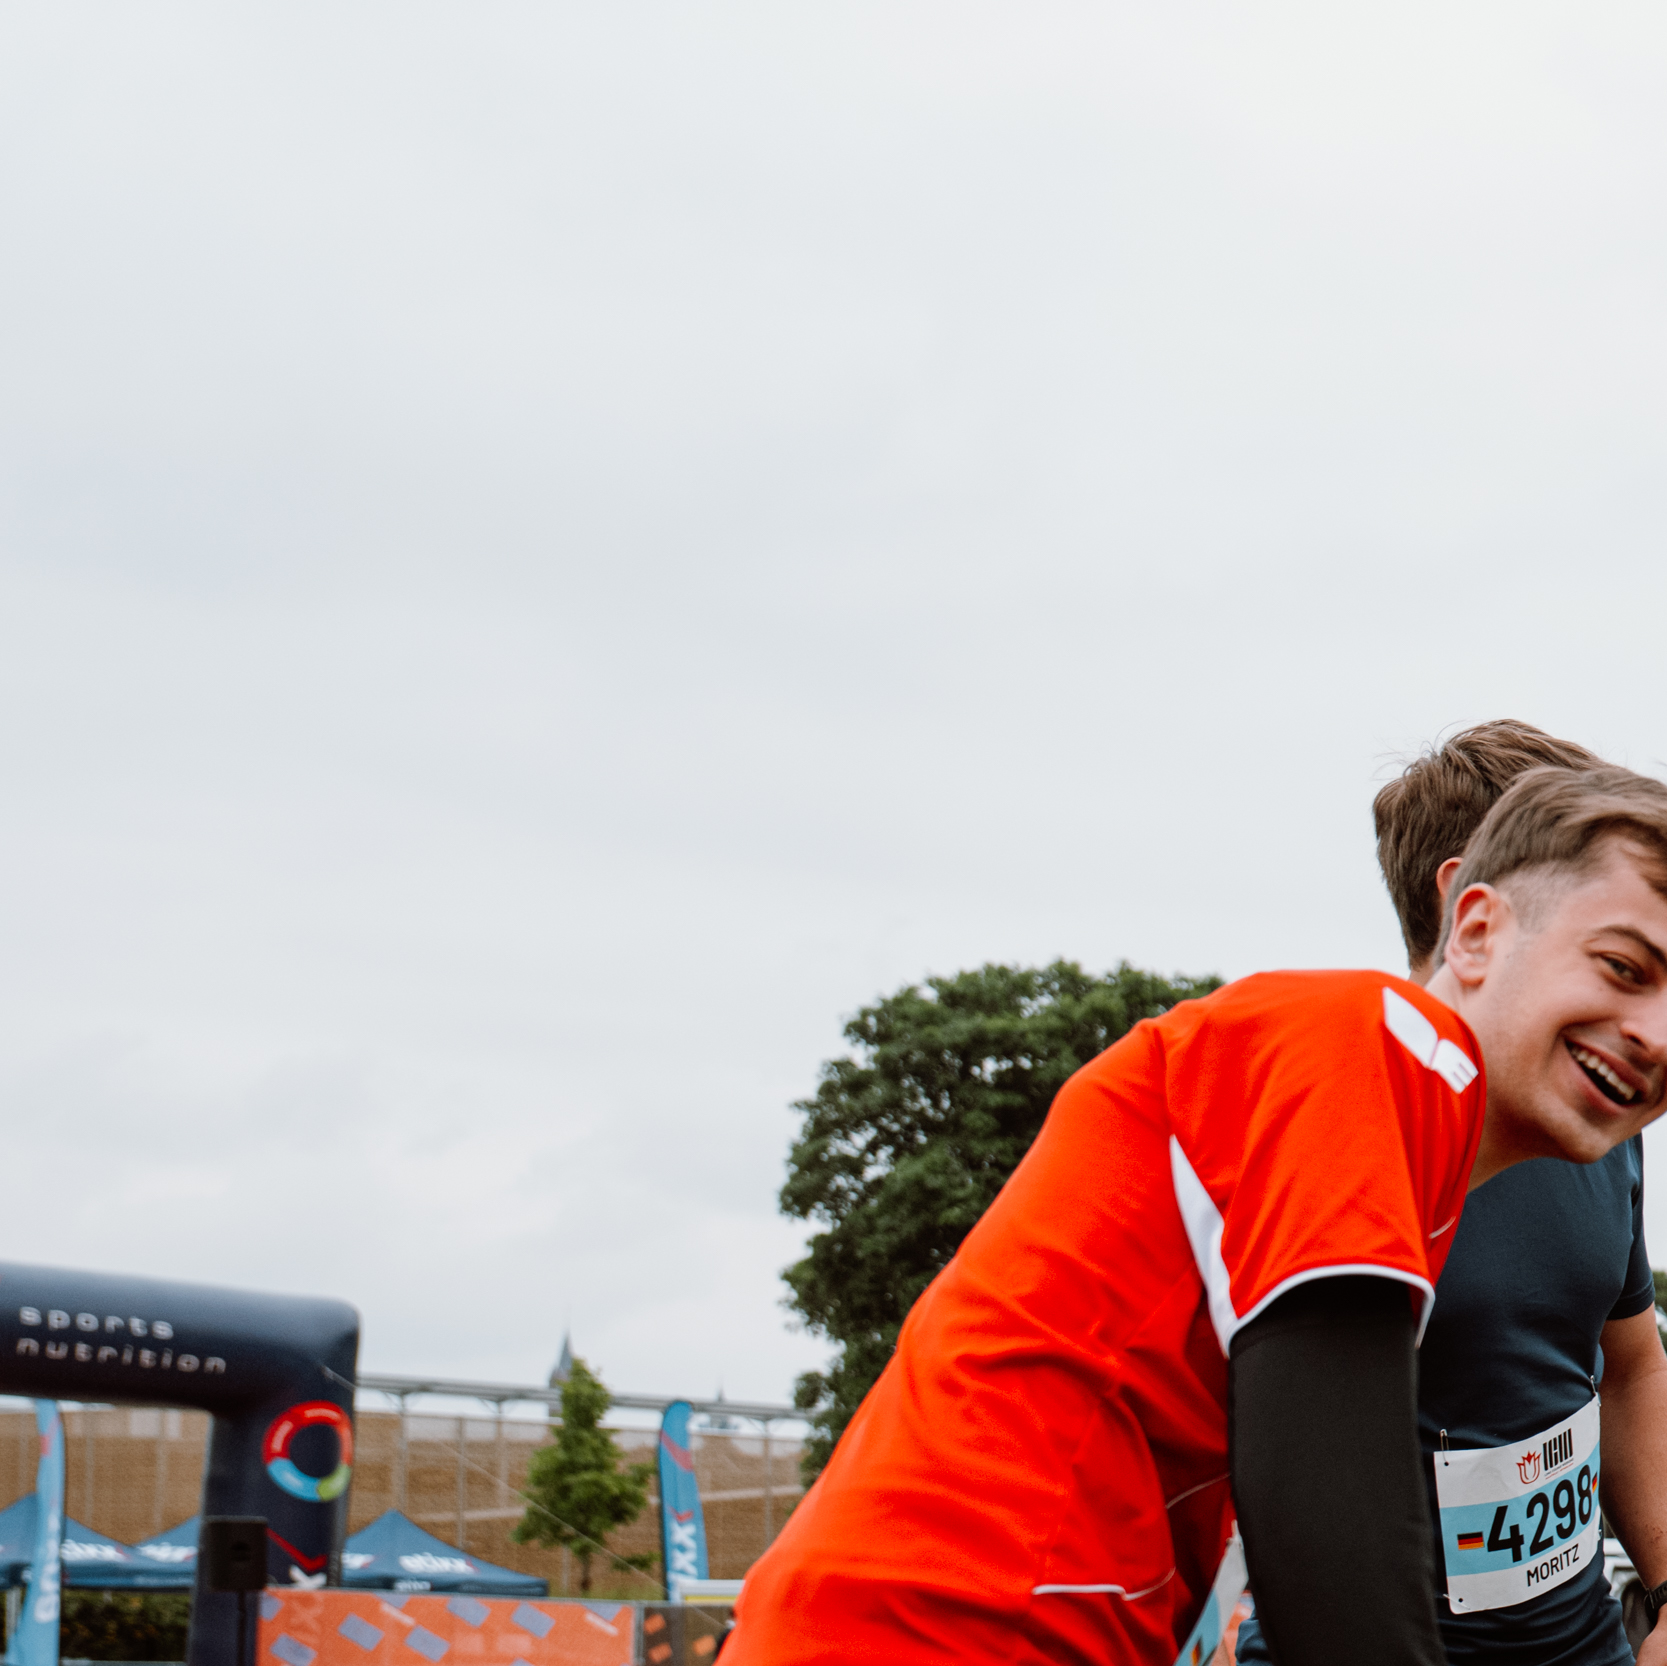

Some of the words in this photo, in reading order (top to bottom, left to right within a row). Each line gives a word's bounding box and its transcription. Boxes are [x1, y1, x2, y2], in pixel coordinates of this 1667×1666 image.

[19, 1306, 174, 1340] sports
[16, 1337, 227, 1374] nutrition
[1487, 1464, 1592, 1562] 4298
[1527, 1543, 1580, 1587] MORITZ
